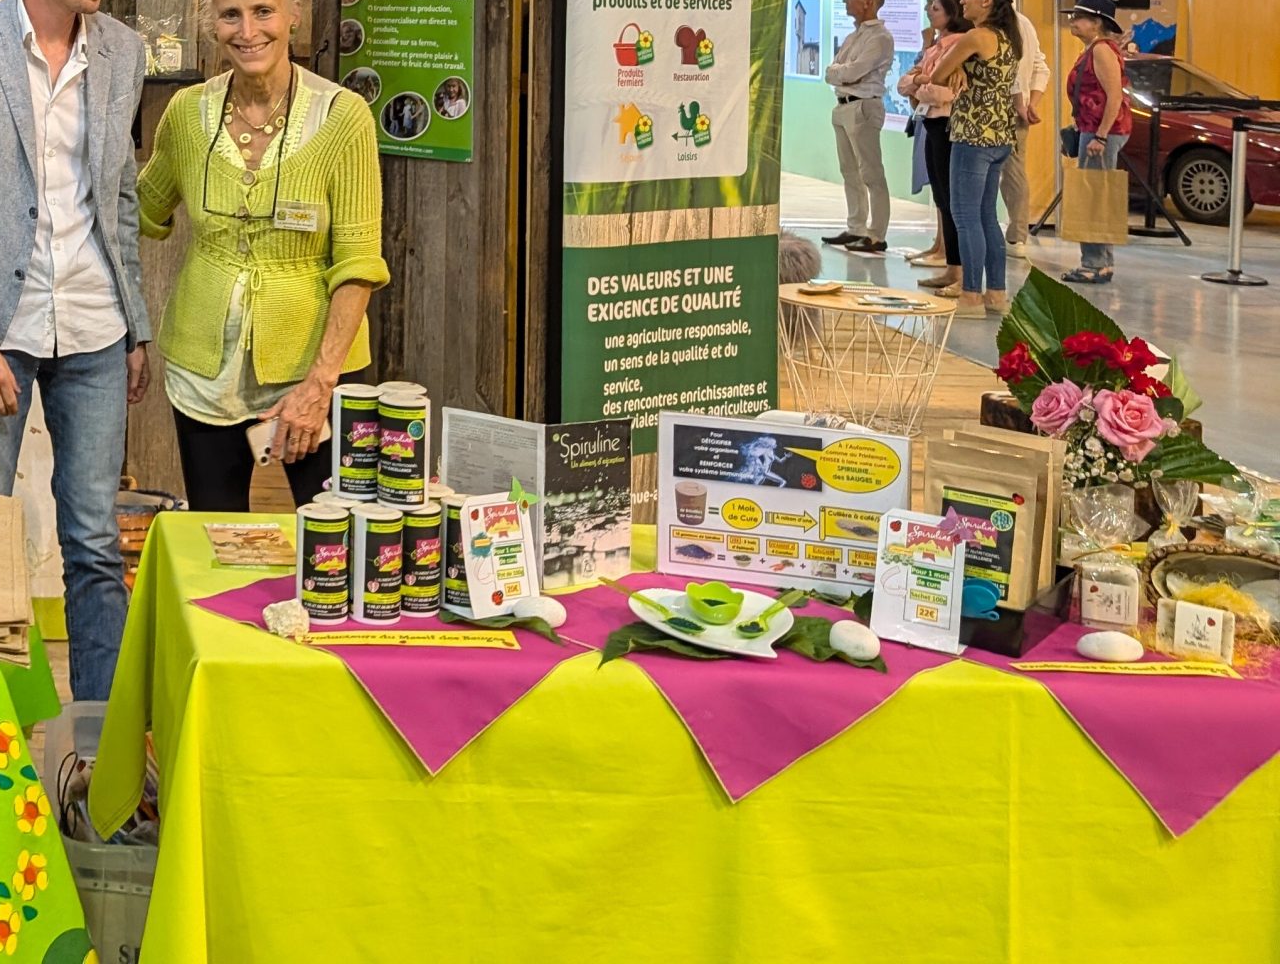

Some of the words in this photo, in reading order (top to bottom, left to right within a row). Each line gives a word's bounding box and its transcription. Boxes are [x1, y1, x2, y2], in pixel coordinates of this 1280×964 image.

[618, 69, 644, 78] Produits
[673, 73, 710, 82] Restauration
[618, 78, 644, 87] fermiers
[678, 152, 697, 162] Loisirs
[587, 276, 619, 296] DES
[621, 269, 681, 293] VALEURS
[684, 268, 701, 285] ET
[704, 265, 734, 284] UNE
[587, 297, 658, 323] EXIGENCE
[661, 295, 679, 315] DE
[681, 285, 741, 314] QUALITÉ
[605, 335, 625, 349] une
[627, 327, 682, 349] agriculture
[685, 320, 752, 341] responsable,
[604, 359, 618, 373] un
[620, 356, 643, 371] sens
[645, 351, 658, 366] de
[660, 350, 670, 365] la
[672, 344, 709, 366] qualité
[711, 345, 722, 359] et
[725, 342, 738, 357] du
[603, 378, 643, 397] service,
[603, 400, 622, 416] des
[624, 392, 677, 413] rencontres
[680, 382, 755, 405] enrichissantes
[757, 380, 767, 394] et
[560, 430, 620, 460] Spiruline
[699, 460, 733, 469] RENFORCER
[846, 476, 872, 485] BAUGES
[737, 505, 755, 513] Mois
[728, 513, 738, 521] de
[740, 514, 758, 523] Cure
[913, 525, 951, 541] Spiruline
[912, 566, 926, 574] Pour
[934, 571, 949, 580] mois
[911, 590, 931, 600] Sachet
